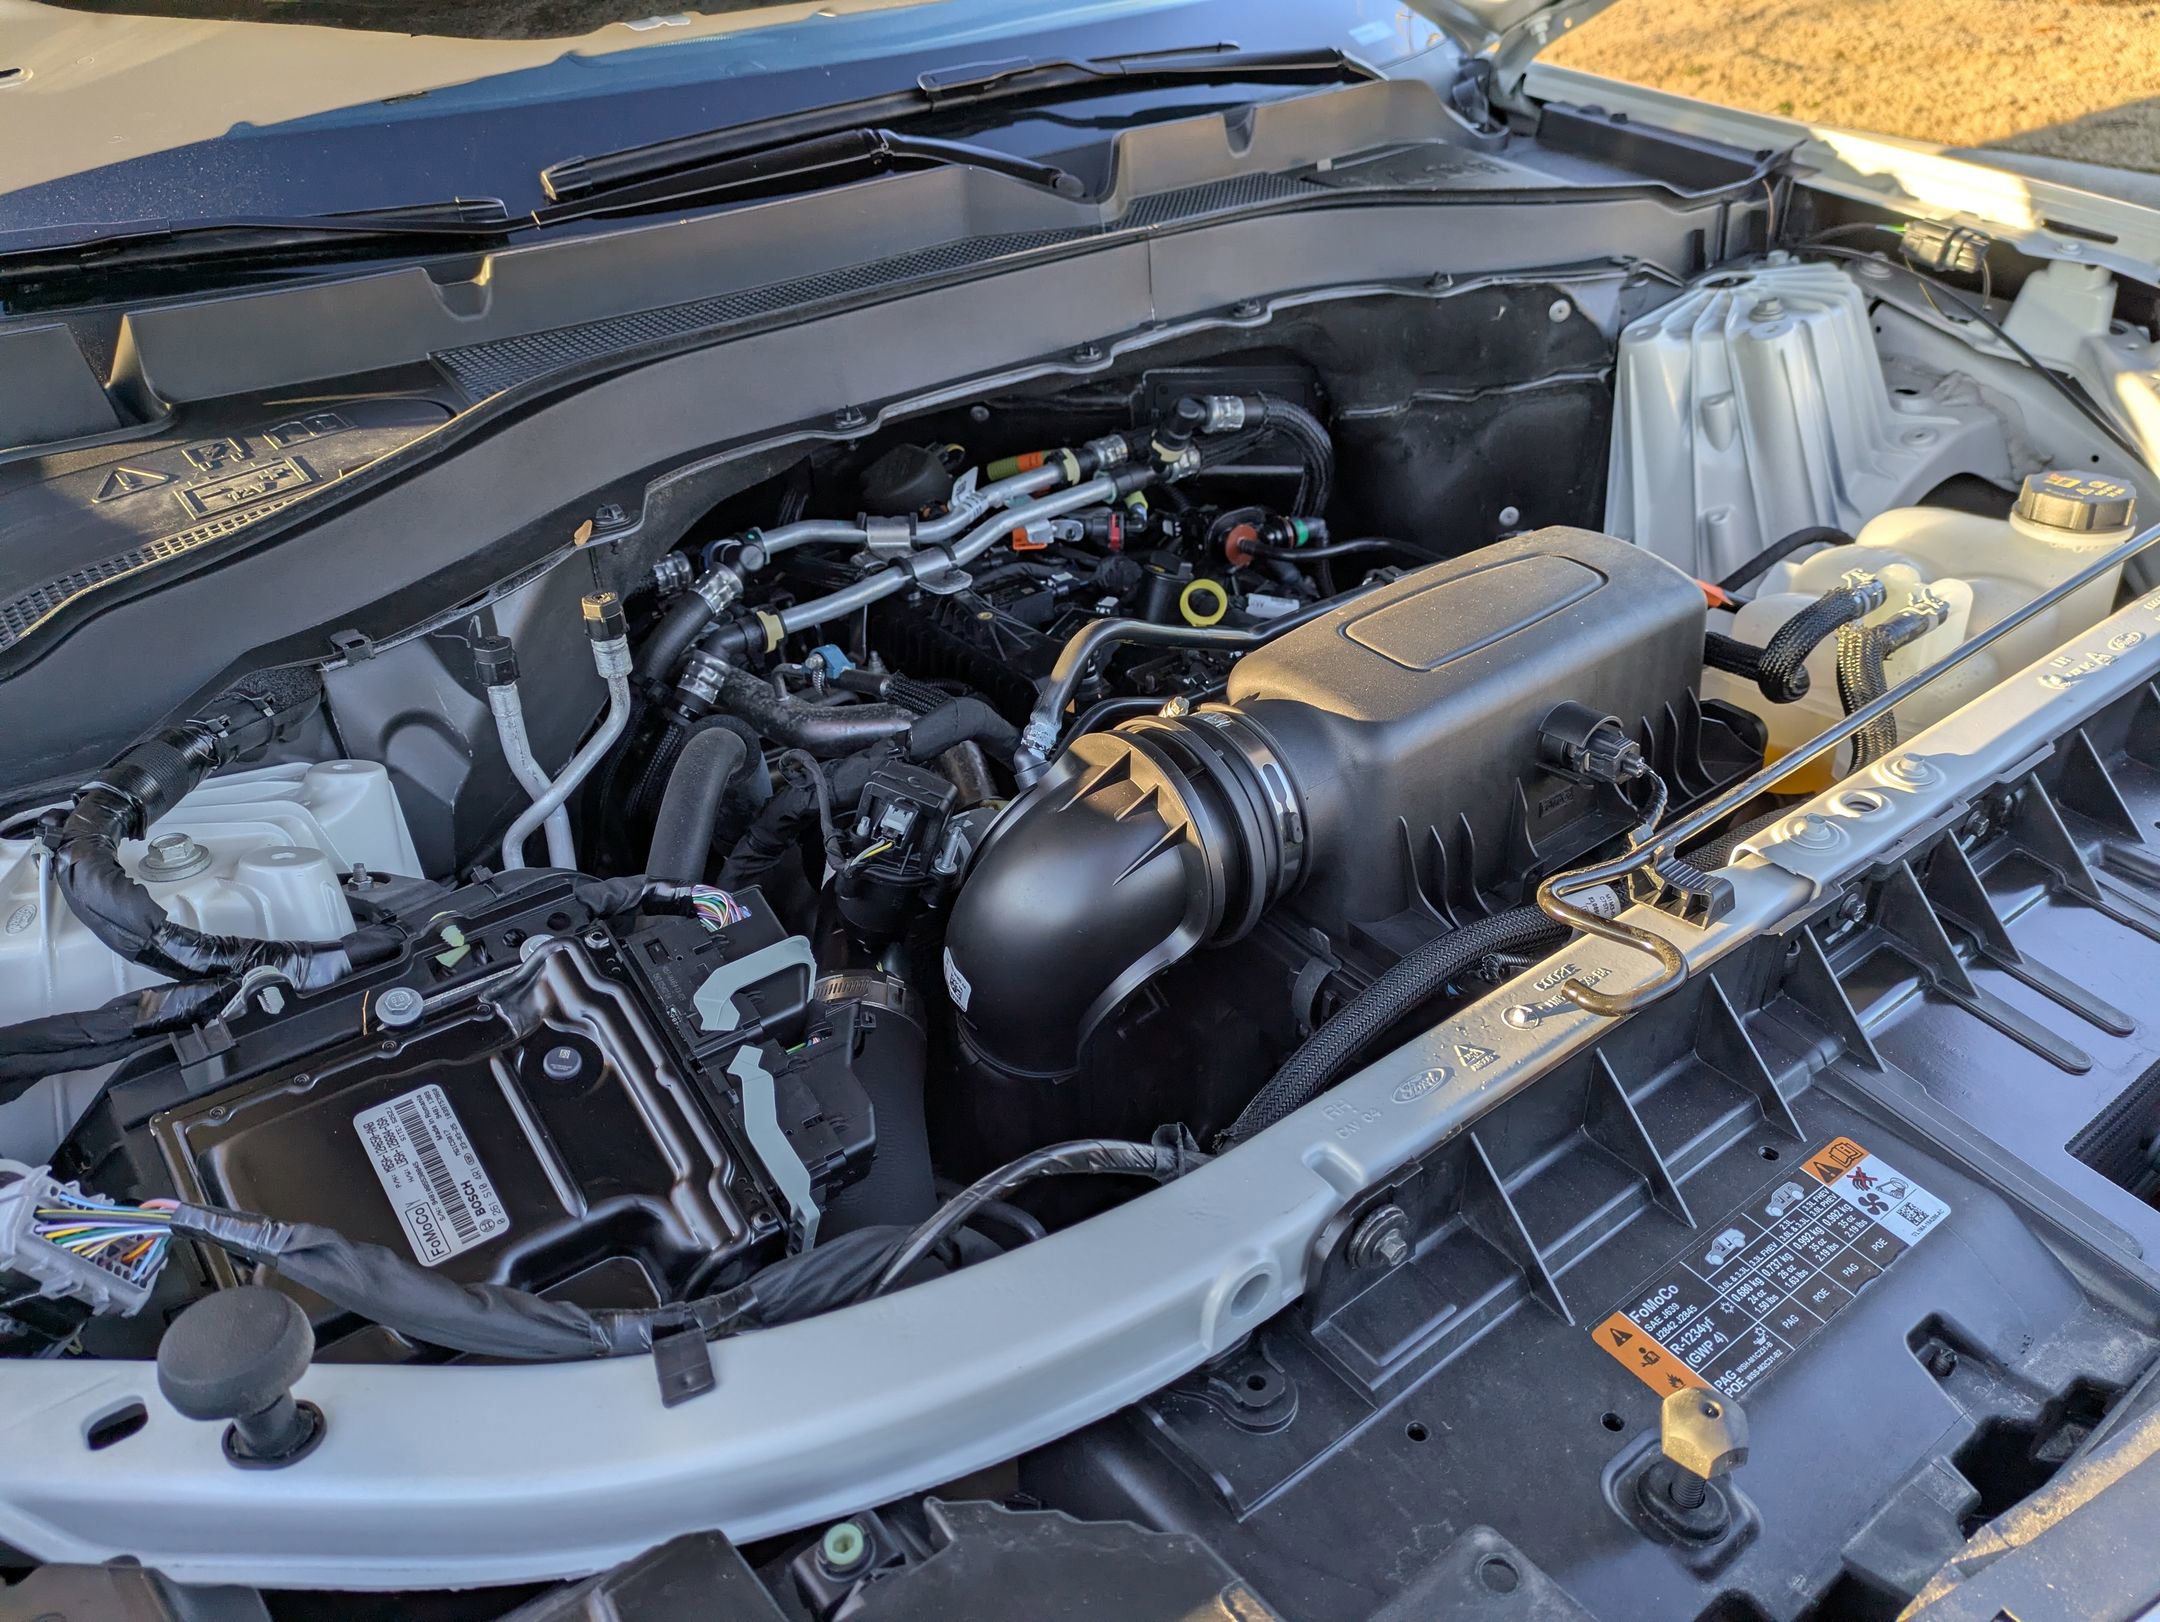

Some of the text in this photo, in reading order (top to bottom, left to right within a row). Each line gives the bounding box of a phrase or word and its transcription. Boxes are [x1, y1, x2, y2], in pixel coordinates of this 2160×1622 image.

[416, 1094, 431, 1118] Romania
[431, 1124, 443, 1141] Made
[460, 1179, 486, 1217] BOSCH
[1801, 1188, 1829, 1211] 3.3L FHEV
[1819, 1193, 1837, 1208] PHEV
[488, 1201, 501, 1216] 261
[1821, 1203, 1853, 1226] 0.992 kg
[1837, 1214, 1856, 1229] 35 oz
[1843, 1219, 1868, 1238] 2.19 lbs
[415, 1207, 444, 1257] FoMoCo
[1792, 1226, 1825, 1250] 0.992 kg
[1760, 1241, 1778, 1257] FHEV
[1808, 1238, 1827, 1252] 35 oz
[1814, 1242, 1839, 1262] 2.19 lbs
[1871, 1237, 1888, 1252] POE
[1761, 1252, 1794, 1277] 0.737 kg
[1777, 1264, 1797, 1280] 26 oz
[1842, 1263, 1859, 1277] PAG
[1784, 1269, 1809, 1288] 1.63 lbs
[1730, 1276, 1765, 1302] 0.680 kg
[1747, 1289, 1767, 1305] 24 oz
[1812, 1287, 1830, 1302] POE
[1629, 1285, 1678, 1323] FoMoCo
[1754, 1294, 1779, 1314] 1.50 lbs
[1644, 1302, 1680, 1332] SAE J639
[1655, 1304, 1698, 1341] J2842 J2845
[1781, 1314, 1799, 1329] PAG
[1669, 1316, 1714, 1354] R-1234yf
[1685, 1331, 1729, 1368] (GWP 4)
[1713, 1369, 1737, 1390] PAG
[1722, 1377, 1748, 1398] POE
